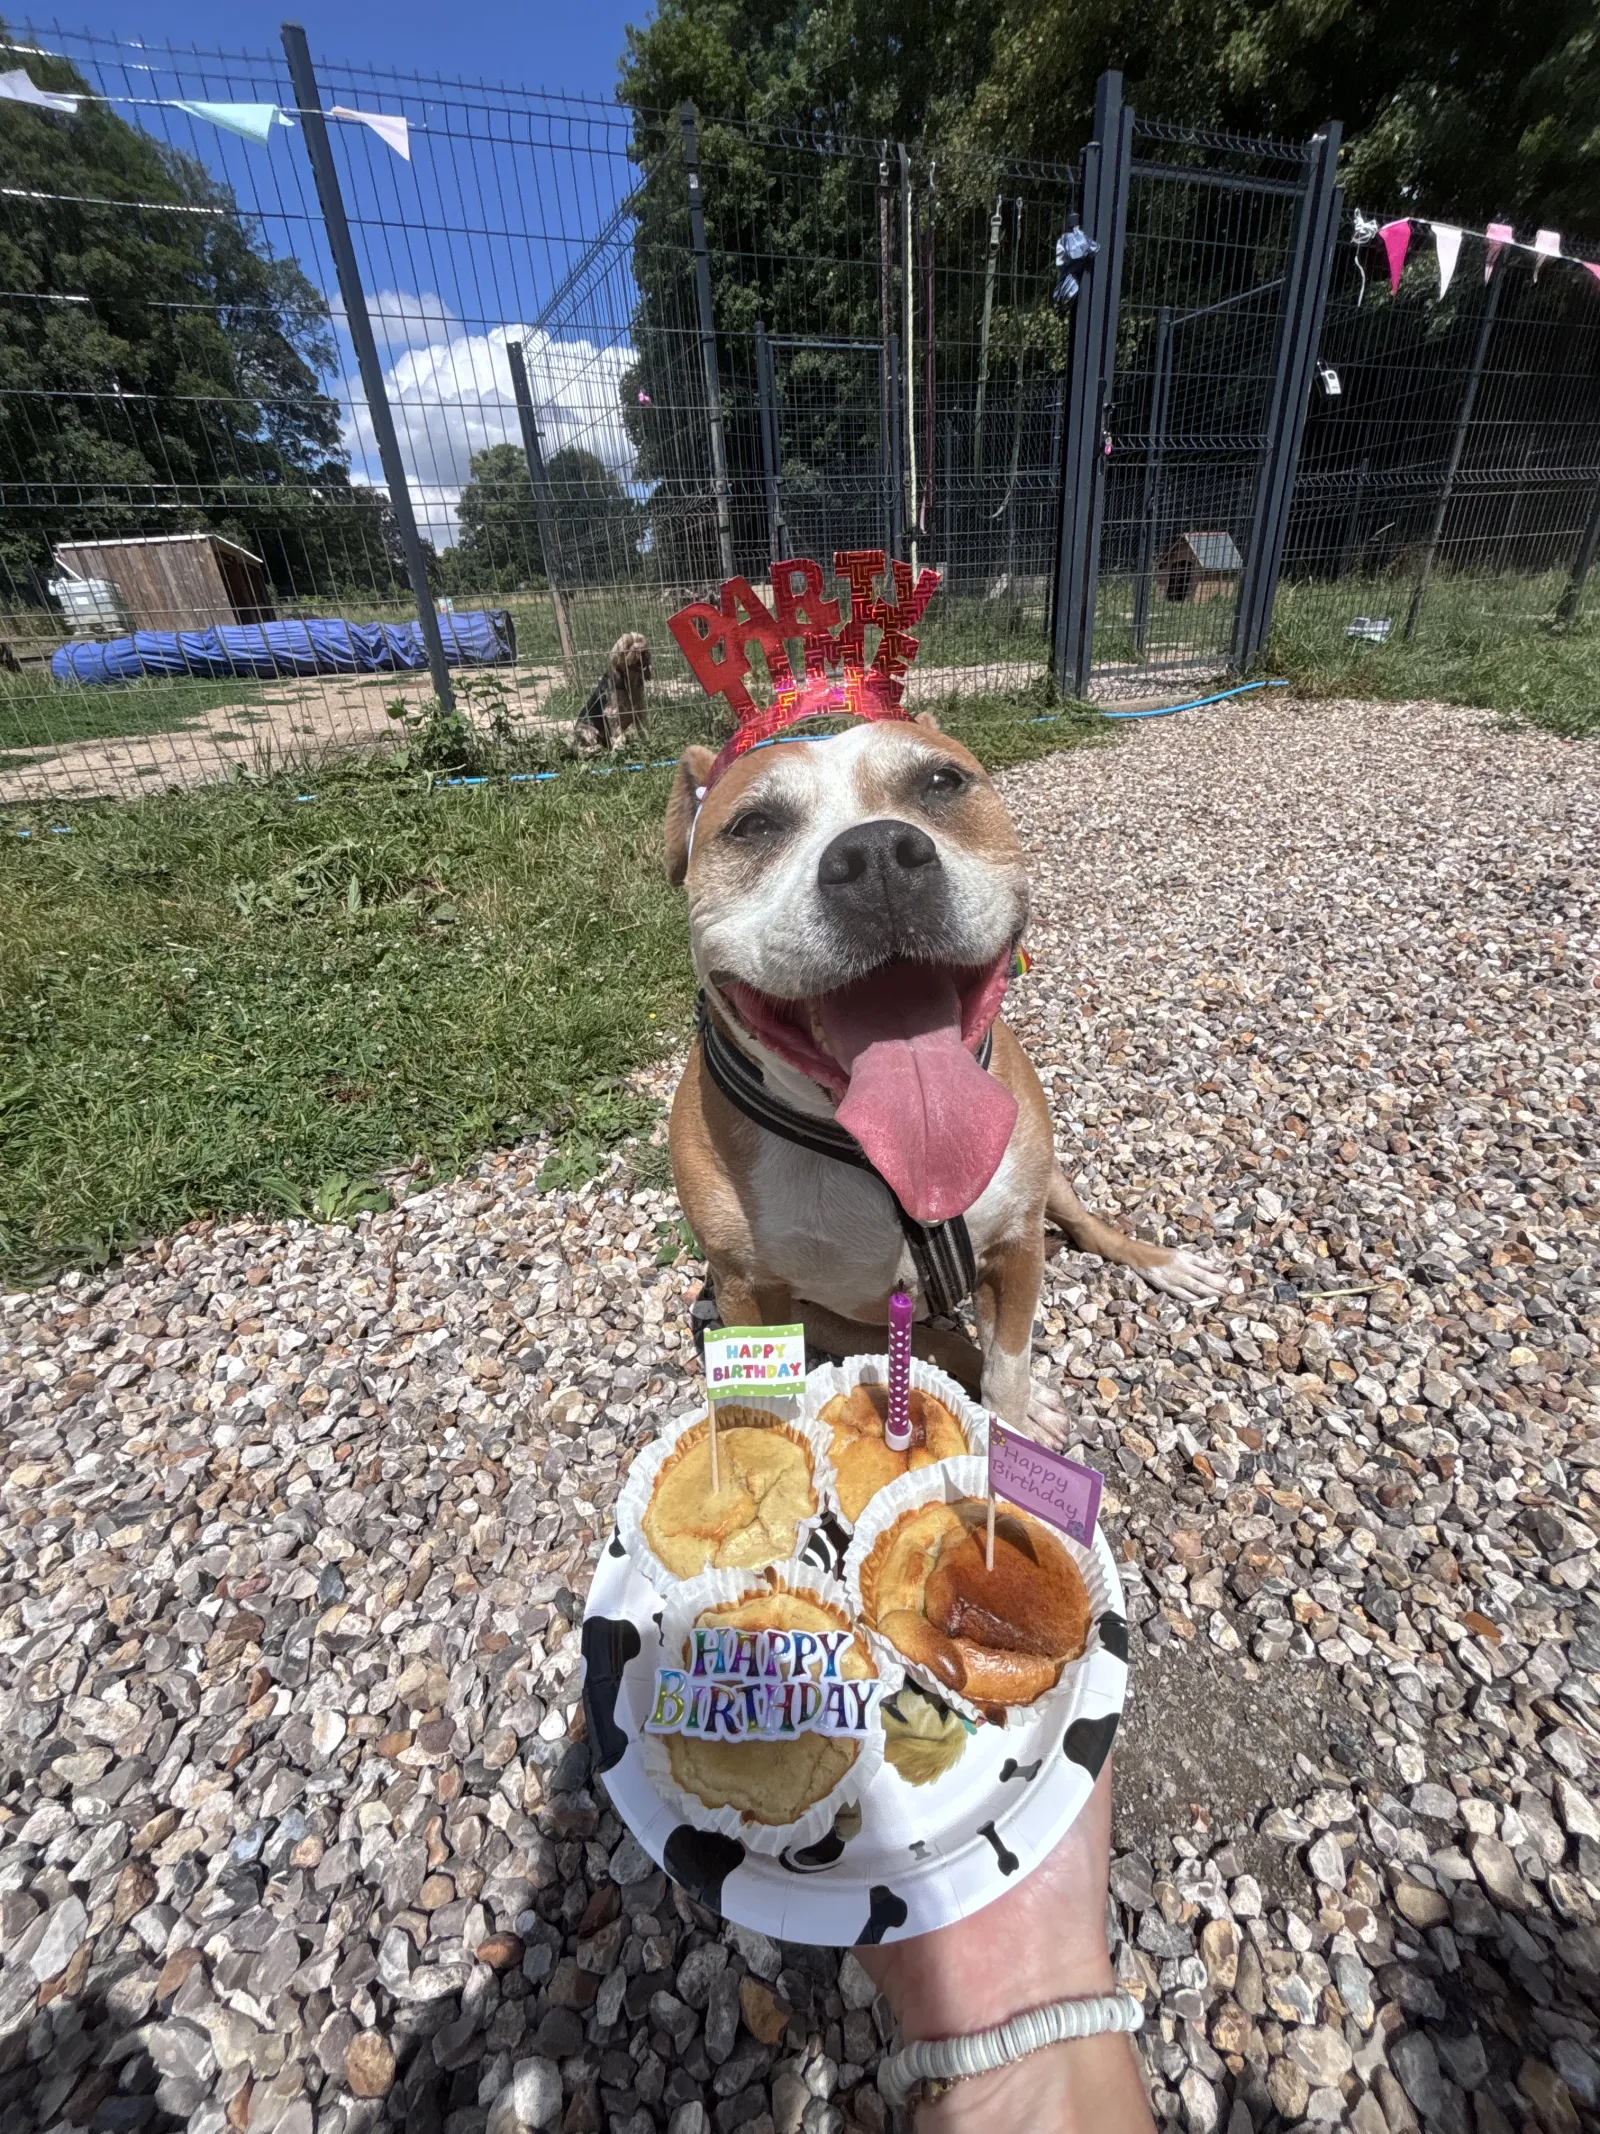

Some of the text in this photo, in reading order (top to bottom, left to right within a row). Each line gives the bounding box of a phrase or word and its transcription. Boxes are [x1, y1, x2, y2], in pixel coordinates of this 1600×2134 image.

[667, 549, 942, 698] PARTY
[713, 1361, 802, 1382] BIRTHDAY
[726, 1343, 786, 1359] HAPPY
[992, 1459, 1078, 1520] Birthday
[1003, 1445, 1068, 1493] Happy
[692, 1629, 849, 1677] HAPPY
[650, 1670, 880, 1734] BIRTHDAY
